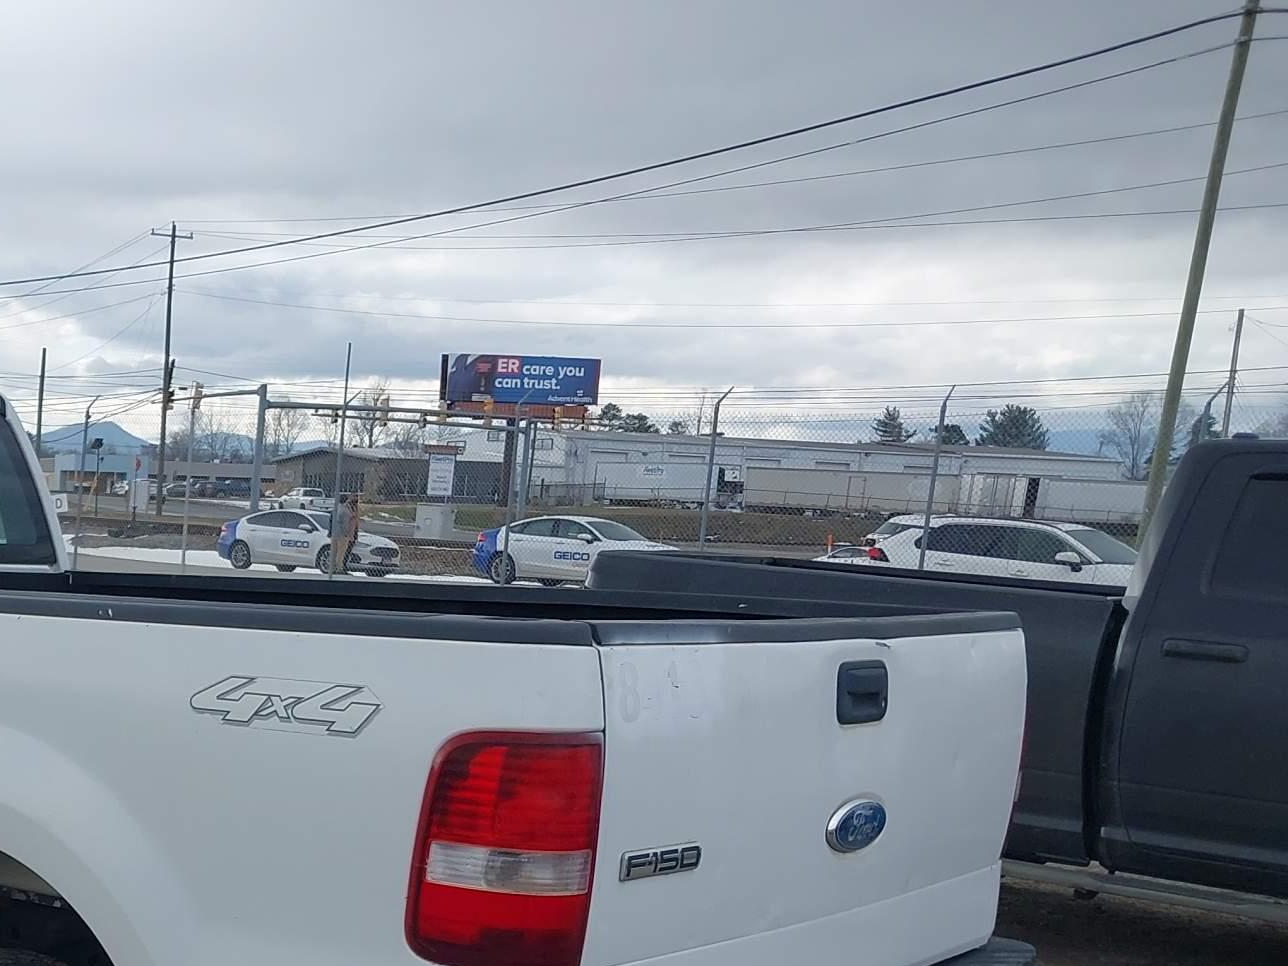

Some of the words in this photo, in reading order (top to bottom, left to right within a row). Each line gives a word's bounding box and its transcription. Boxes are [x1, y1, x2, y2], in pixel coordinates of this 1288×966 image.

[497, 359, 520, 373] ER
[522, 365, 555, 375] care
[558, 366, 585, 379] you
[495, 378, 521, 388] can
[523, 378, 561, 390] trust.
[554, 551, 590, 561] GEICO
[189, 675, 381, 736] 4x4
